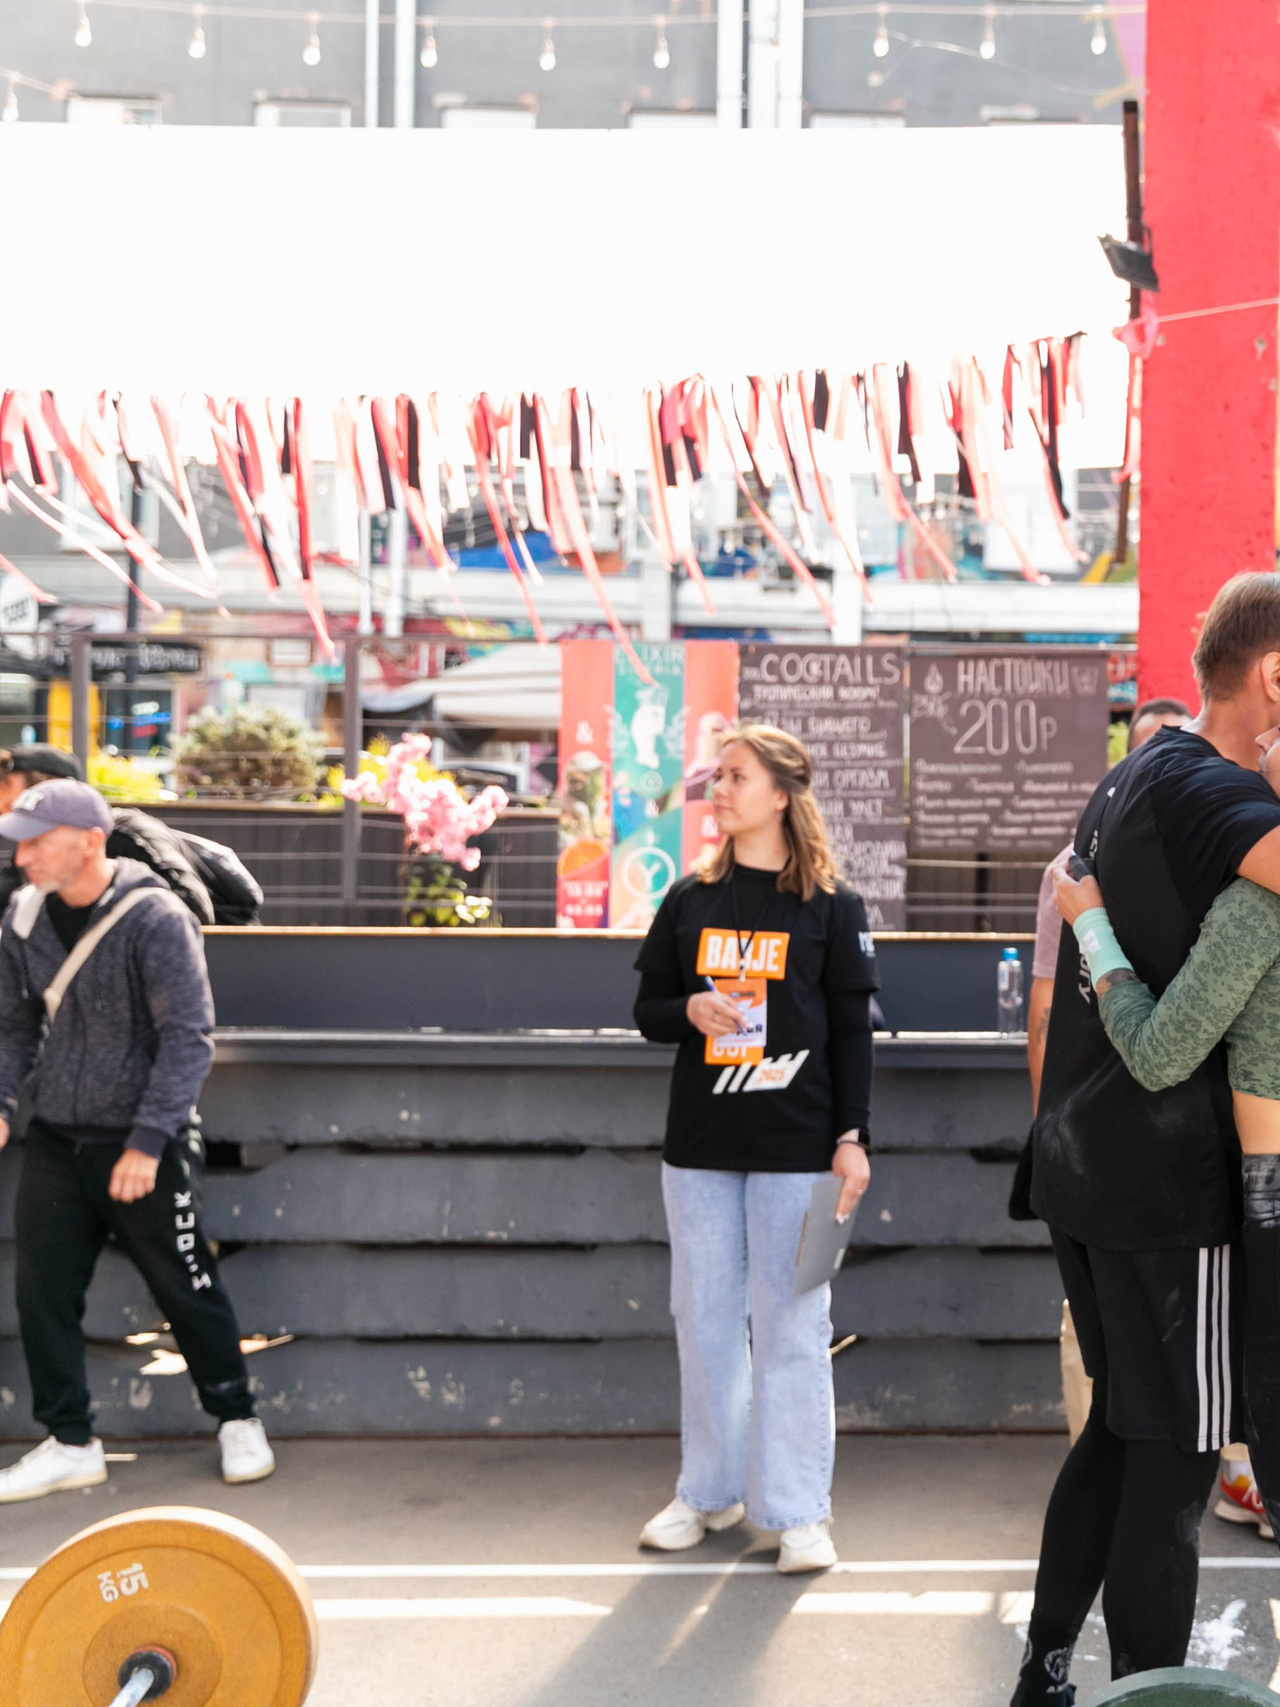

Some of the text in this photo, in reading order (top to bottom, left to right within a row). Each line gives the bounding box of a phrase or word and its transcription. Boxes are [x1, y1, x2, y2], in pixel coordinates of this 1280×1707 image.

[614, 643, 686, 663] EIXIR
[96, 1571, 119, 1603] KG
[116, 1562, 149, 1596] 15
